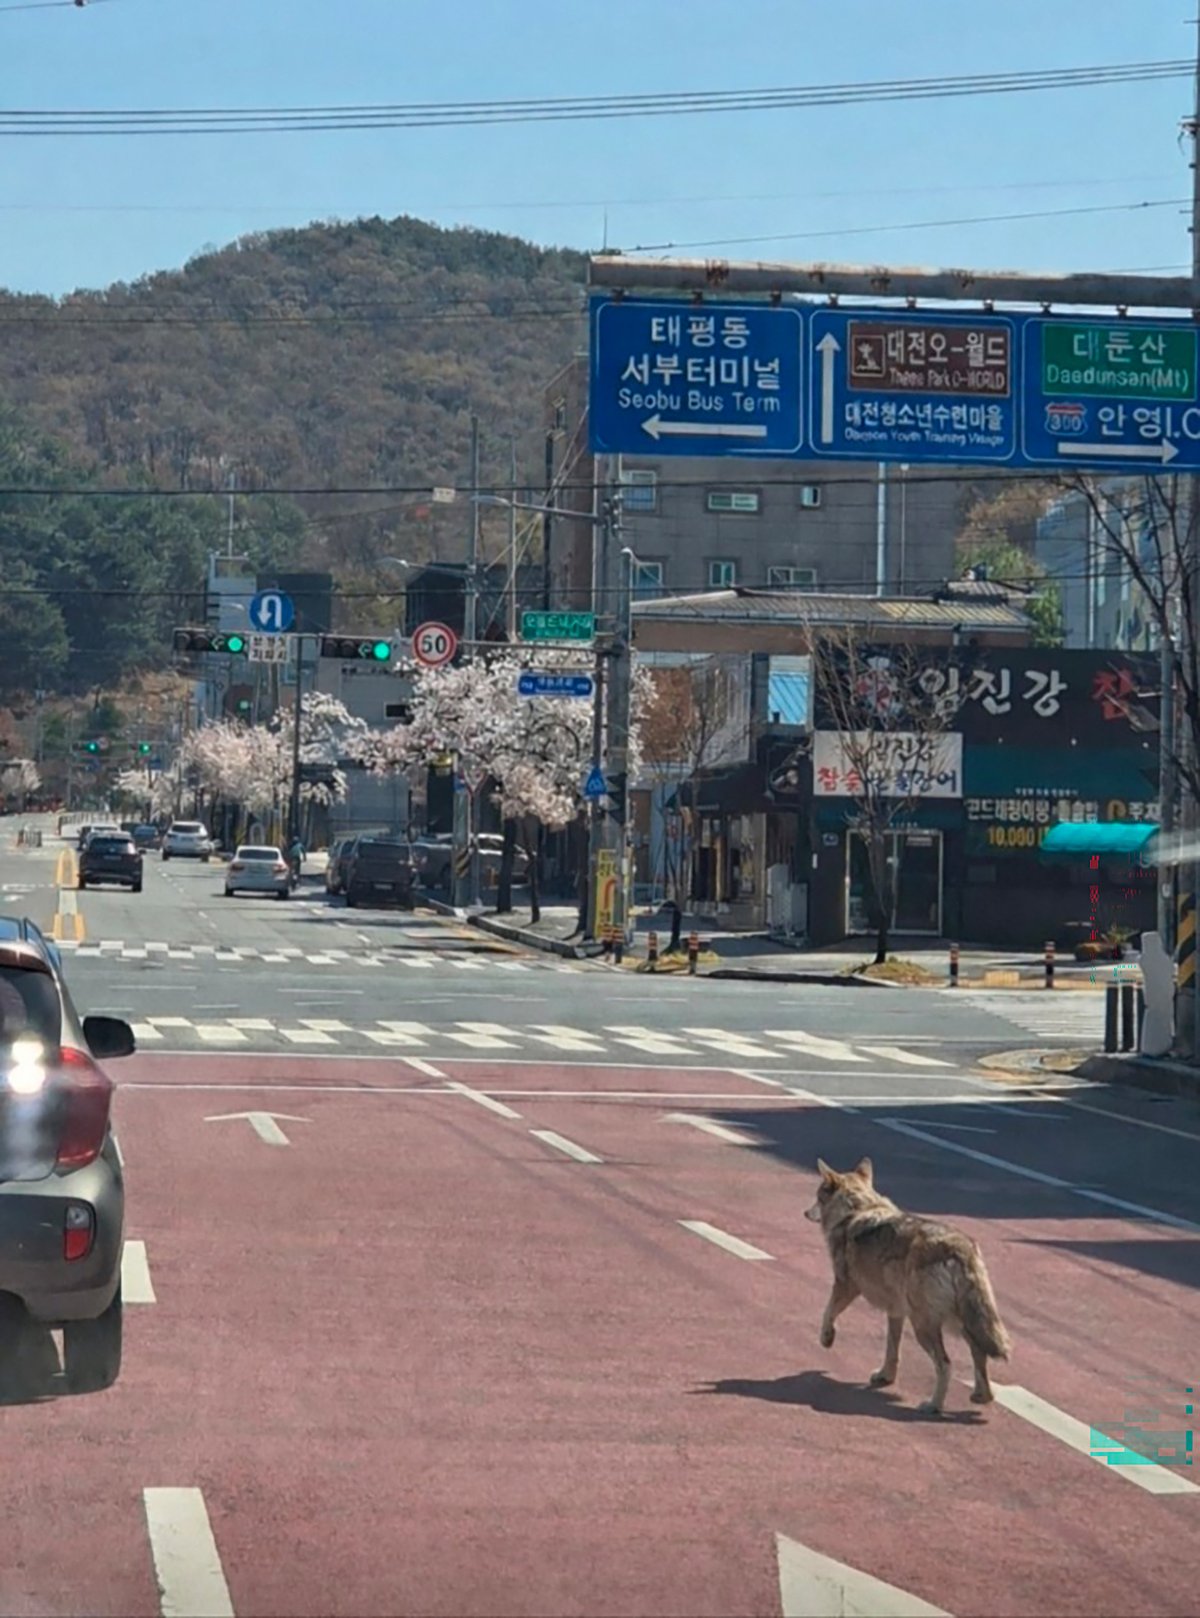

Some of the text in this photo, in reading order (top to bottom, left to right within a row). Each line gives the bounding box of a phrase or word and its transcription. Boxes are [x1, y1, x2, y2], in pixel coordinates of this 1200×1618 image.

[651, 315, 751, 350] 태평동
[887, 330, 1007, 368] 대전오-월드
[1073, 330, 1167, 365] 대둔산
[621, 353, 781, 390] 서부터미널
[618, 388, 781, 413] Seobu Bus Term
[918, 667, 1068, 717] 임진강
